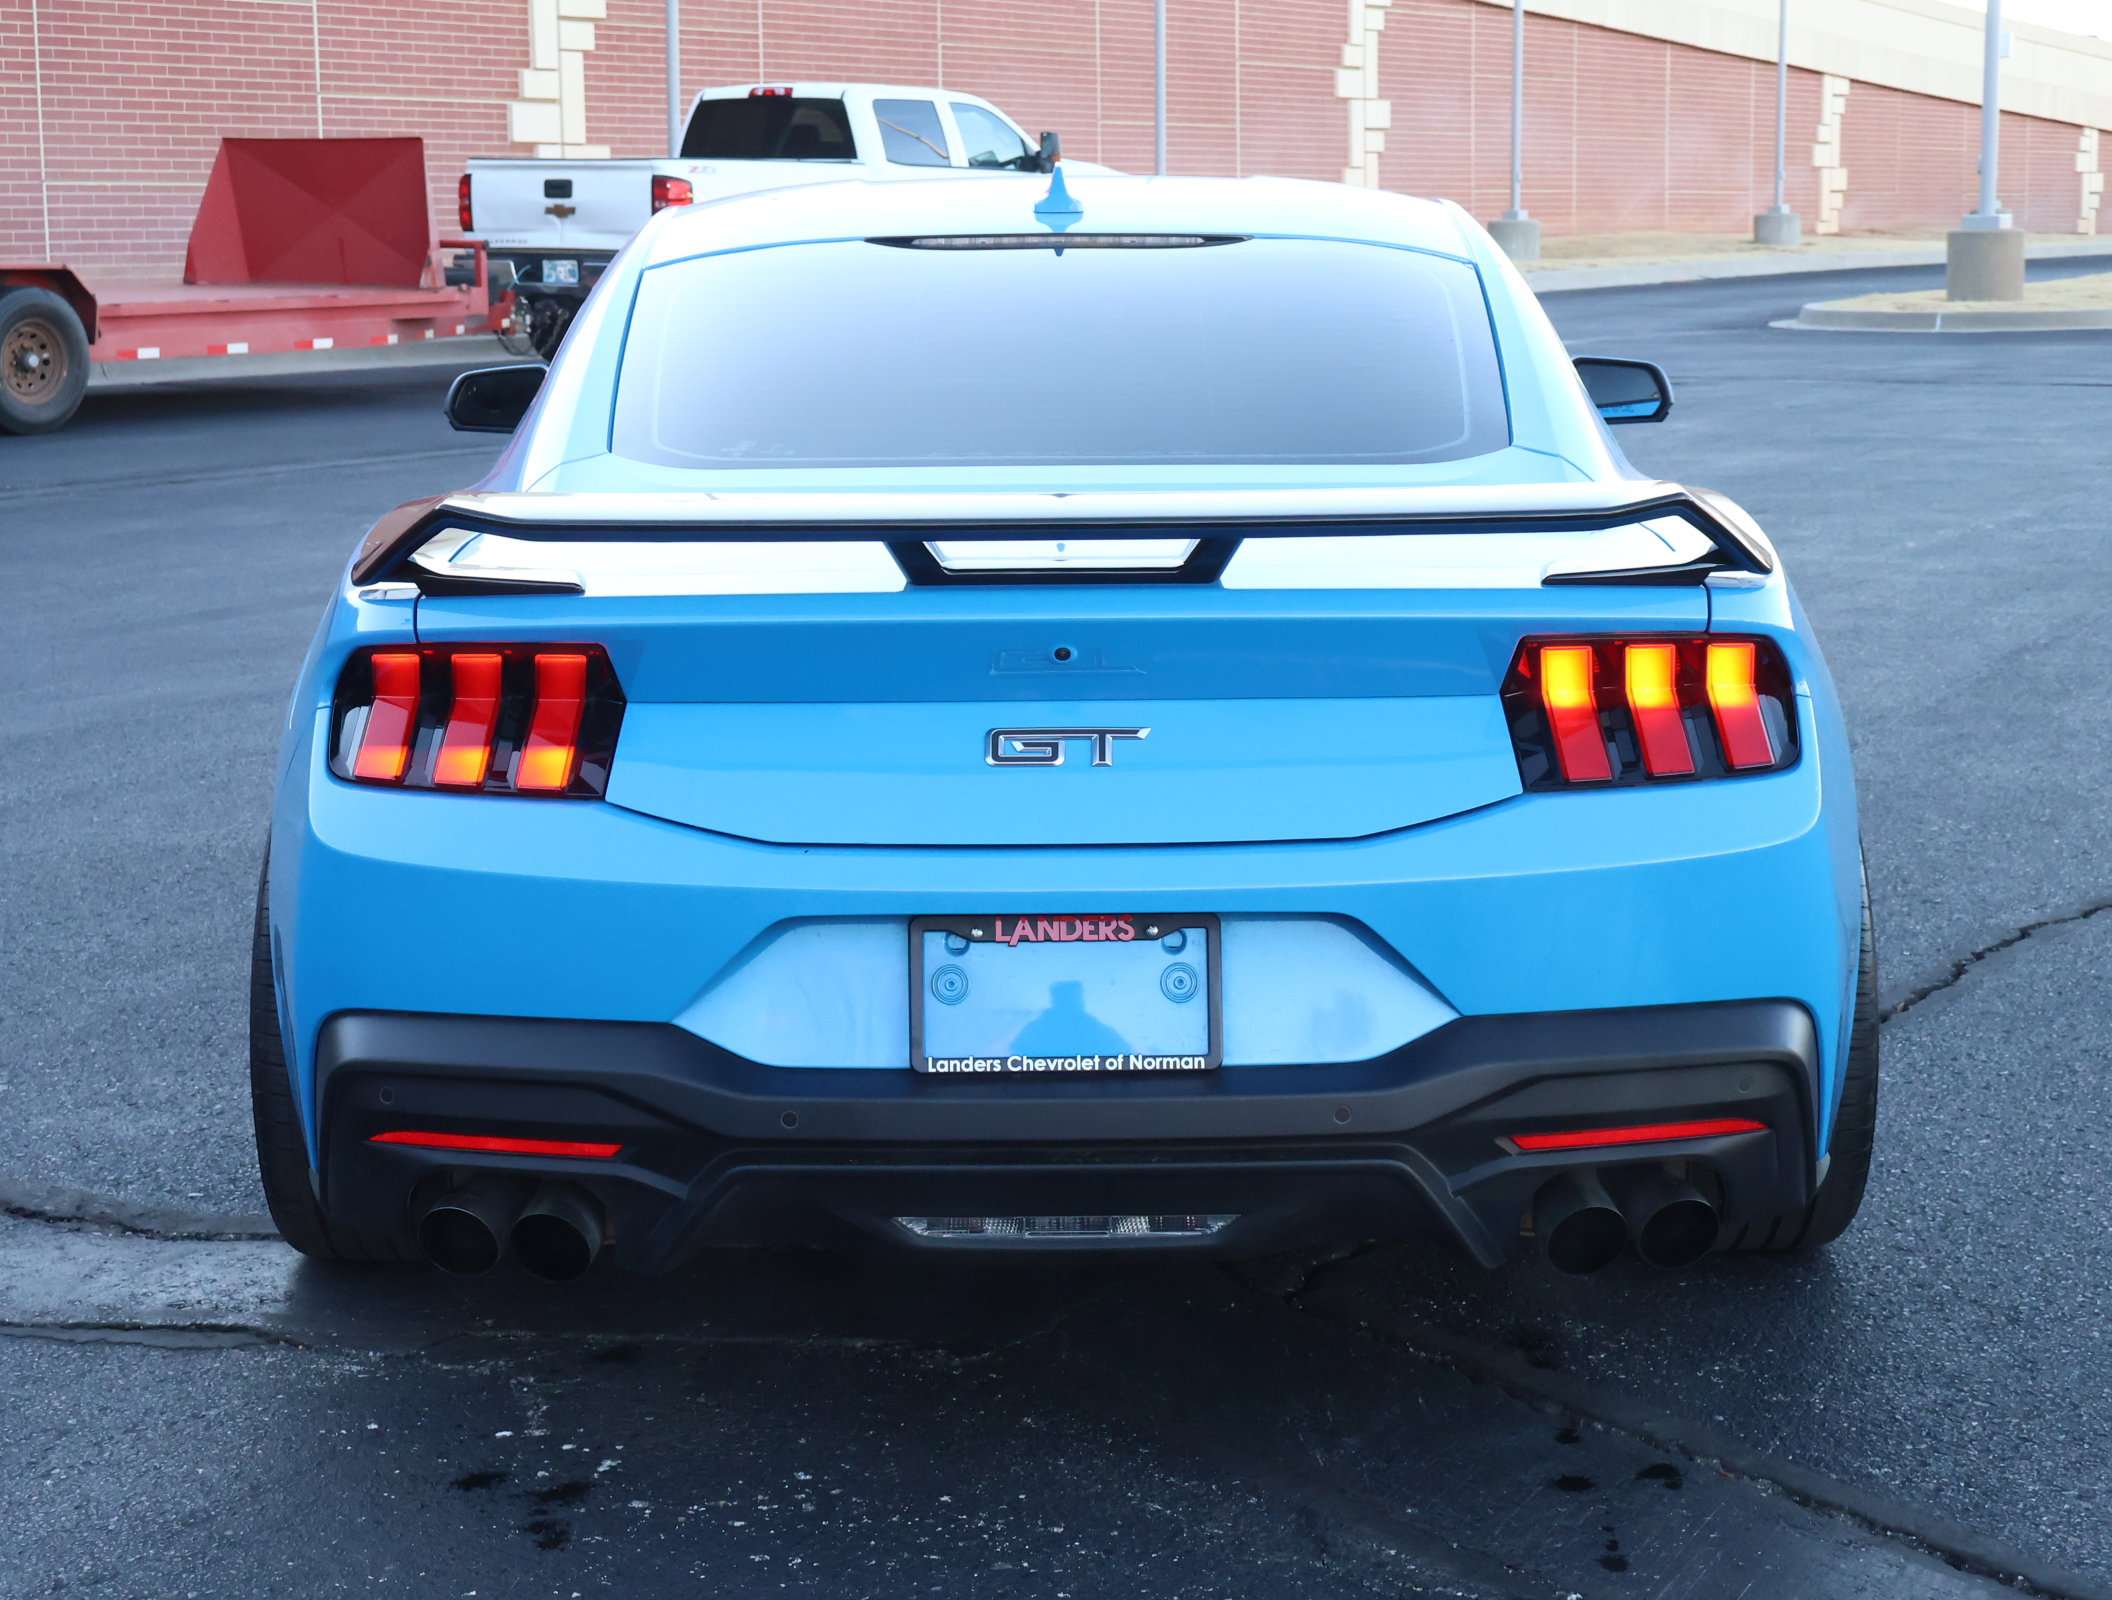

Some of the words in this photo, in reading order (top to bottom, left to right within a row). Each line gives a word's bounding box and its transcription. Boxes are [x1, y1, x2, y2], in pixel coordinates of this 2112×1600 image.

[985, 727, 1152, 766] GT
[995, 914, 1136, 947] LANDERS
[928, 1056, 1002, 1073] Landers
[1006, 1054, 1101, 1072] Chevrolet
[1105, 1053, 1125, 1071] of
[1129, 1054, 1206, 1071] Norman
